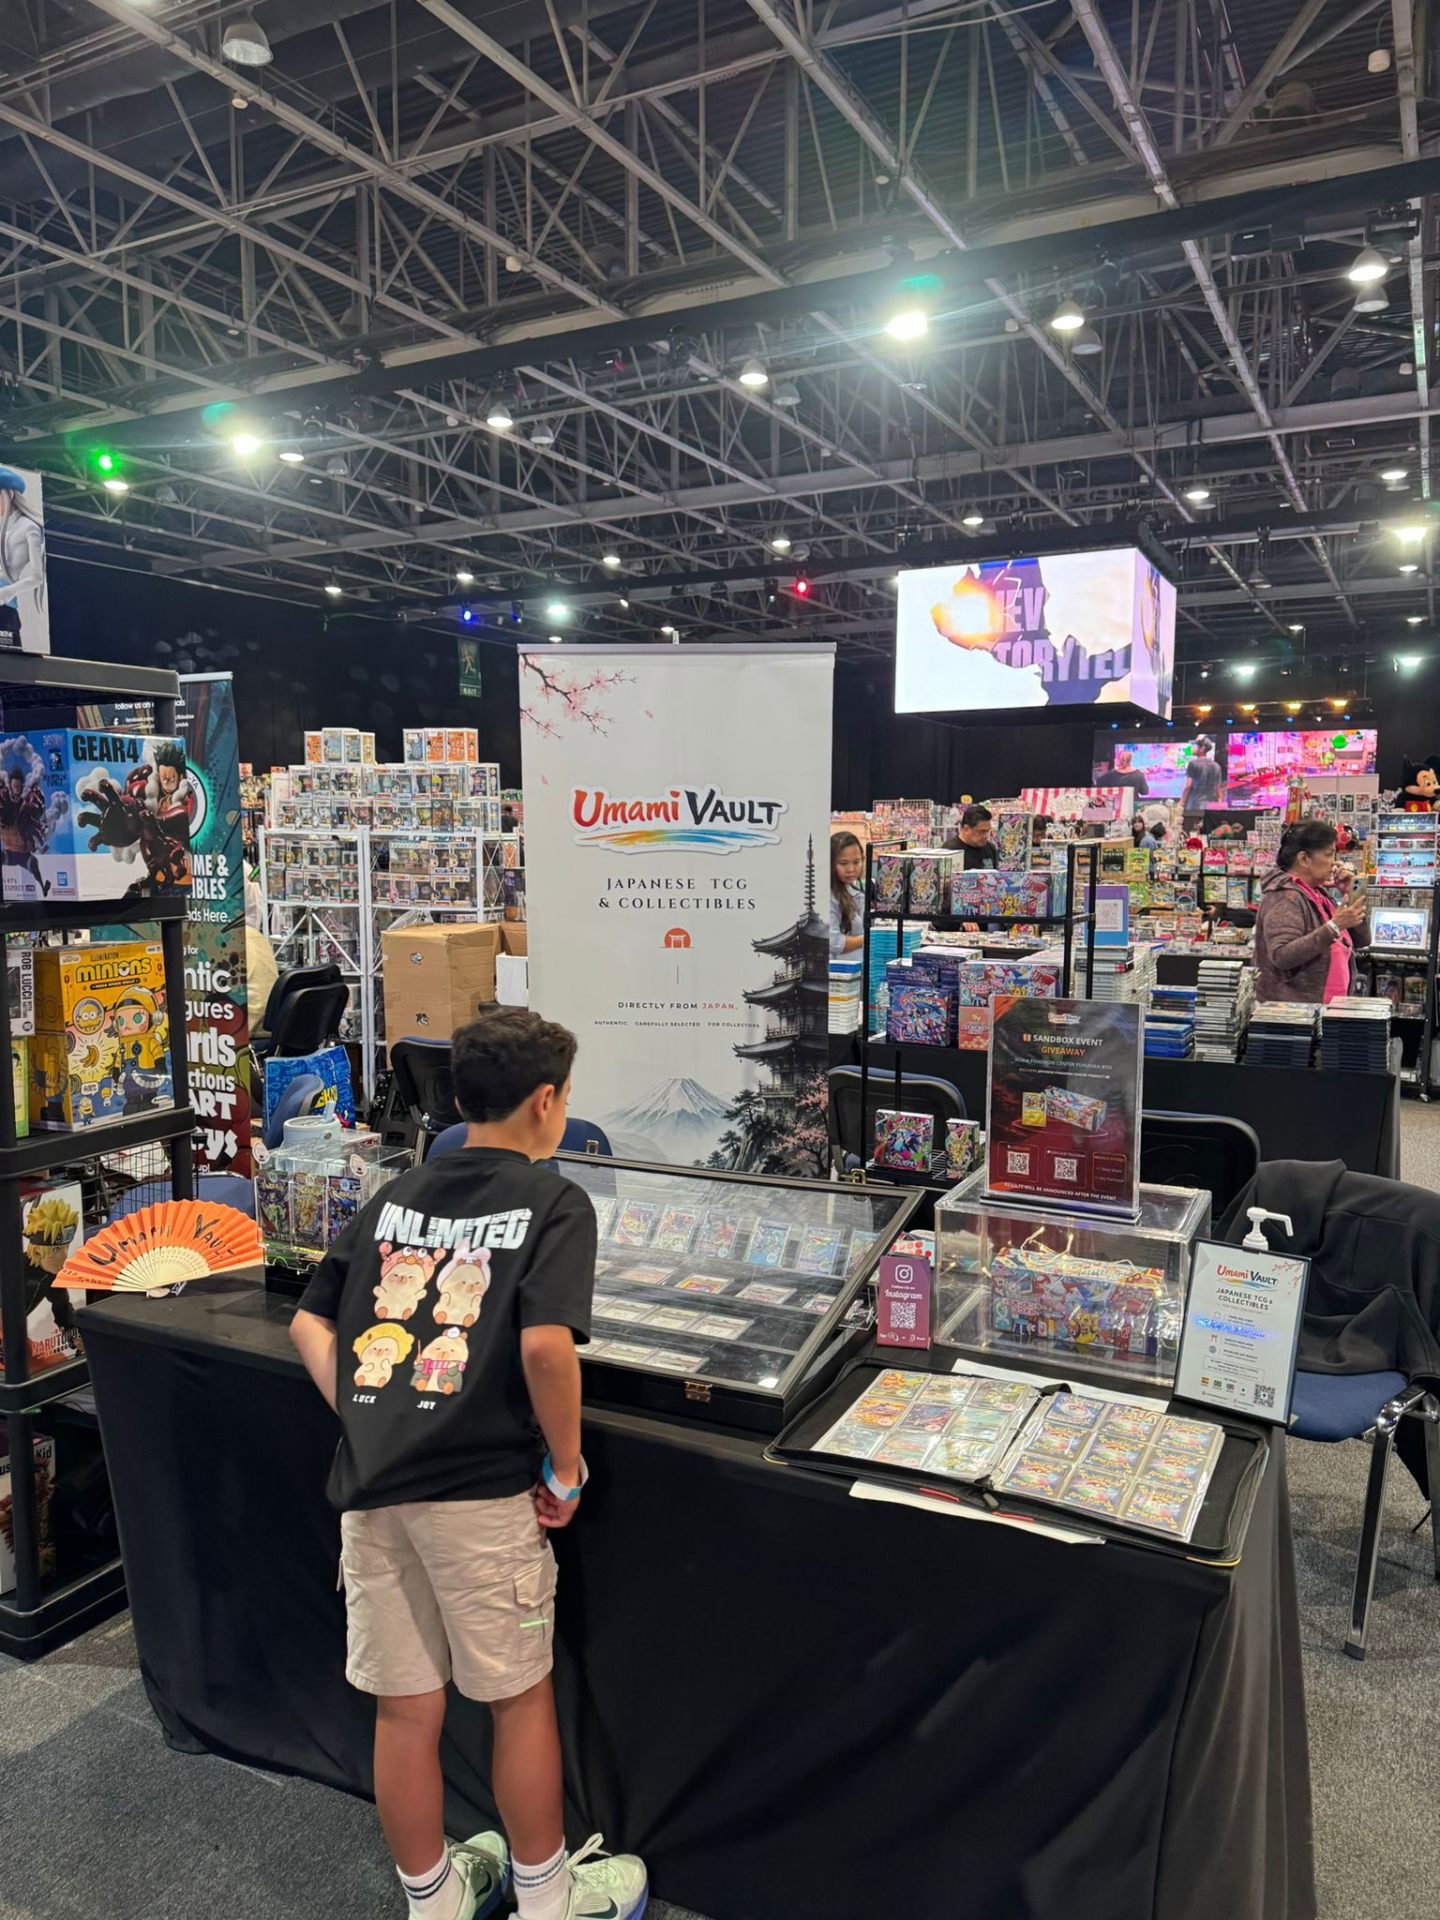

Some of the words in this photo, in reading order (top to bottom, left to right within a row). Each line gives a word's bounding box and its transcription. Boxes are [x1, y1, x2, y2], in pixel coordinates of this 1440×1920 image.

[72, 734, 139, 764] GEAR4
[574, 790, 681, 827] Umami
[685, 788, 782, 825] VAULT
[216, 854, 230, 876] &
[606, 878, 696, 890] JAPANESE
[710, 878, 748, 890] TCG
[598, 898, 610, 908] &
[618, 898, 756, 910] COLLECTIBLES
[203, 908, 231, 922] Here.
[21, 952, 32, 970] ROB
[184, 961, 232, 993] ntic
[22, 974, 32, 999] LUCCI
[1034, 1034, 1074, 1045] SANDBOX
[1076, 1036, 1103, 1046] EVENT
[1041, 1046, 1085, 1056] GIVEAWAY
[1043, 1188, 1074, 1196] ANNOUNCED
[374, 1201, 533, 1250] UNLIMITED
[1216, 1264, 1249, 1279] Umami
[1250, 1271, 1278, 1285] VAULT
[884, 1289, 922, 1300] Instagram
[1216, 1288, 1251, 1300] JAPANESE
[1218, 1296, 1269, 1311] COLLECTIBLES
[352, 1394, 376, 1404] LUCK
[417, 1400, 436, 1410] JOY
